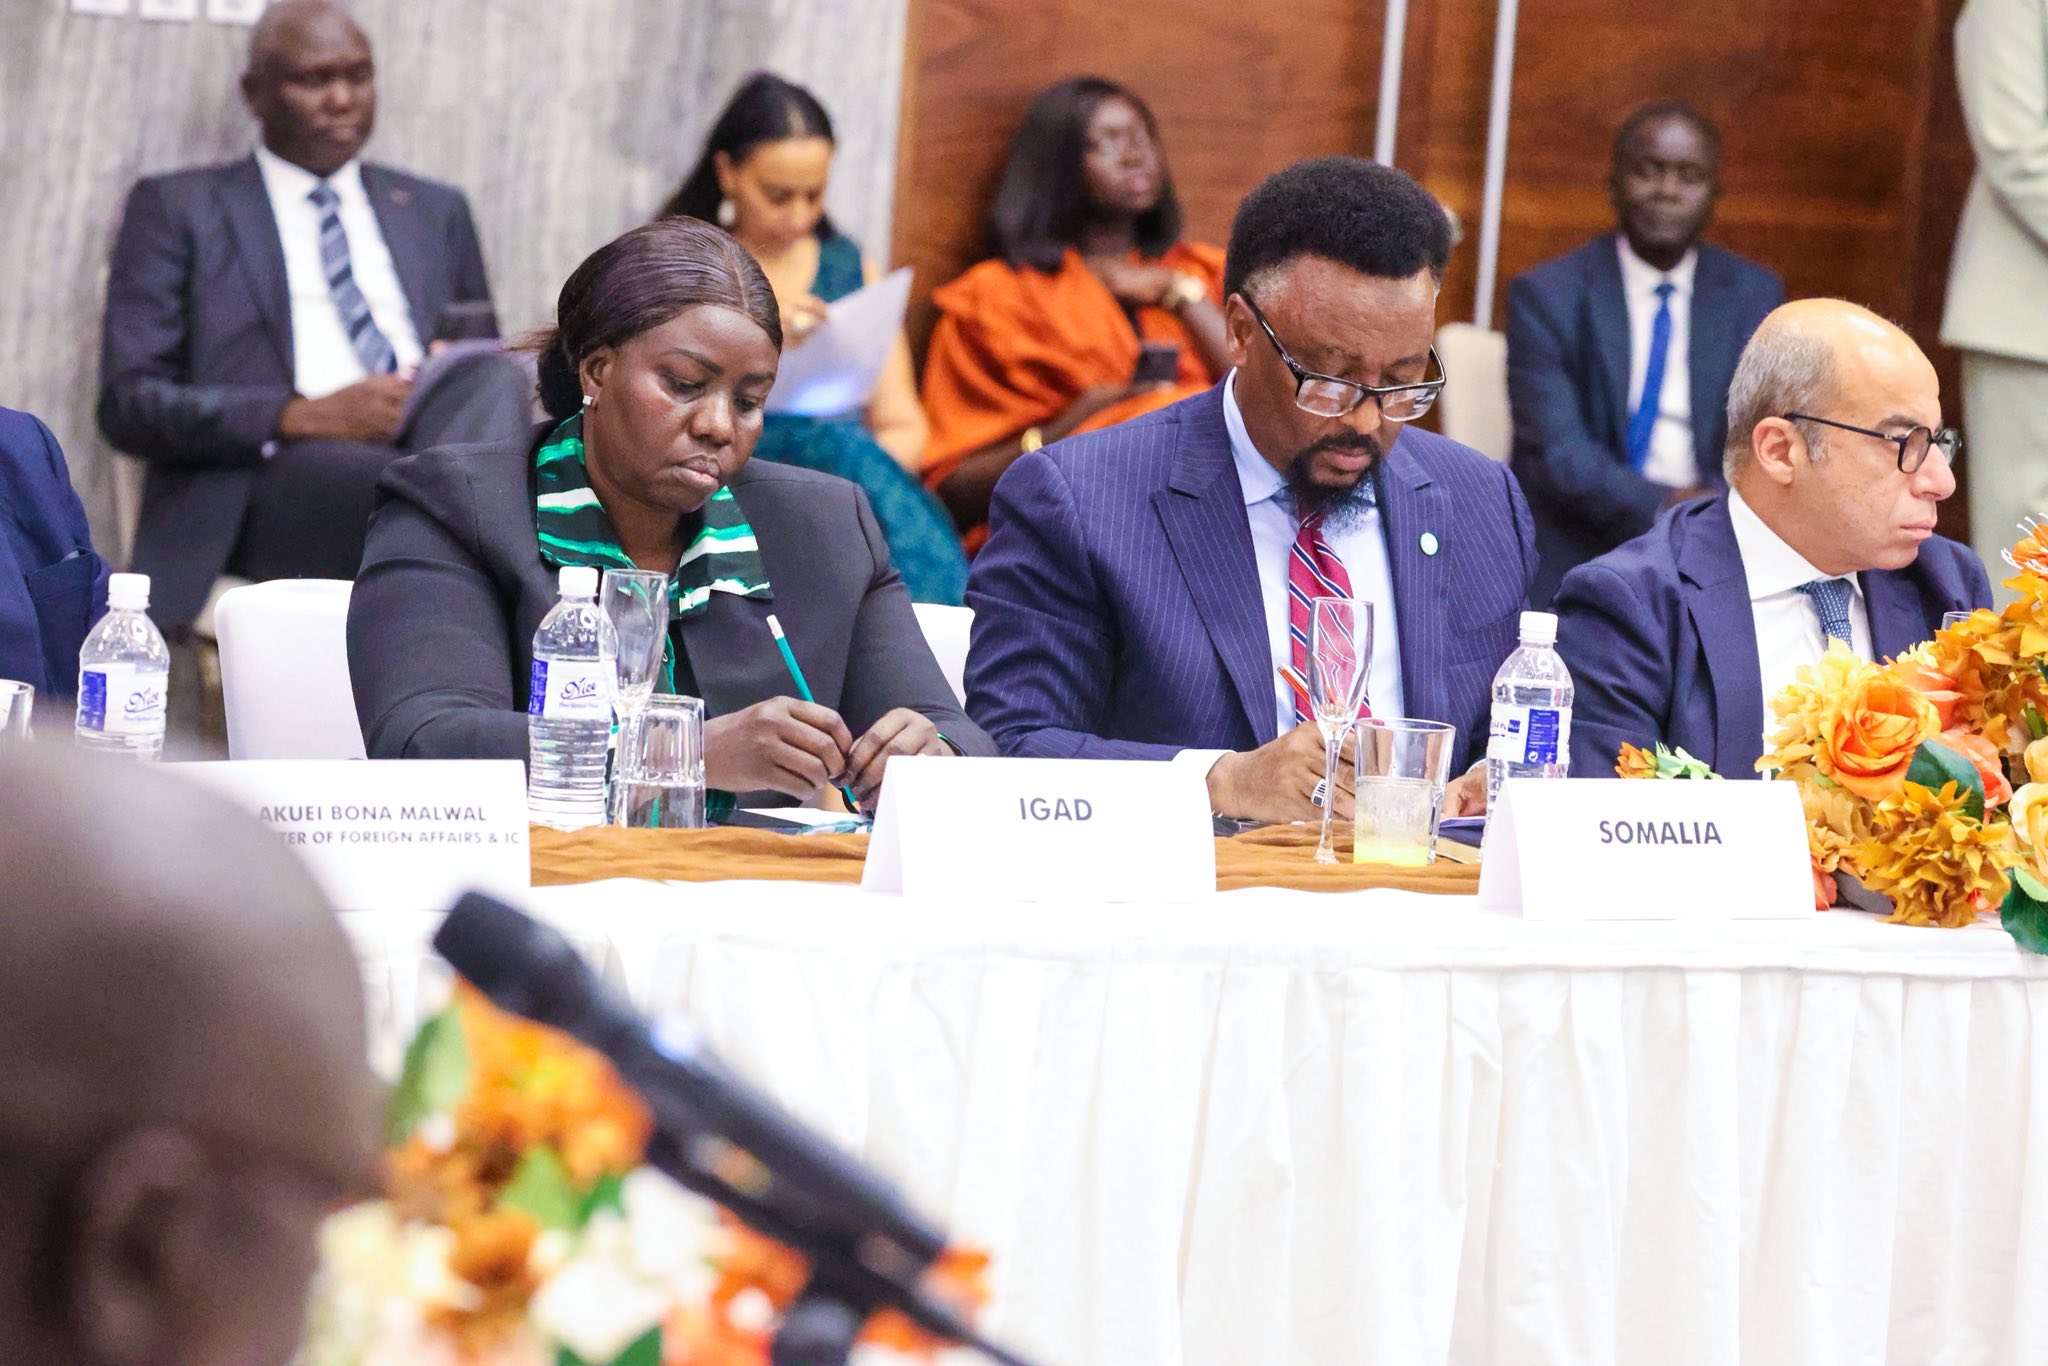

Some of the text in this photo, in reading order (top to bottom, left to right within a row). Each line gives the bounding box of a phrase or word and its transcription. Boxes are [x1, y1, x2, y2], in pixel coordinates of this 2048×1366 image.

[561, 677, 597, 700] Nice
[260, 805, 487, 822] AKUEI BONA MALWAL
[1019, 797, 1092, 821] IGAD
[312, 831, 334, 844] OF
[340, 831, 412, 843] FOREIGN
[419, 831, 482, 843] AFFAIRS
[487, 832, 498, 844] &
[1599, 820, 1722, 844] SOMALIA
